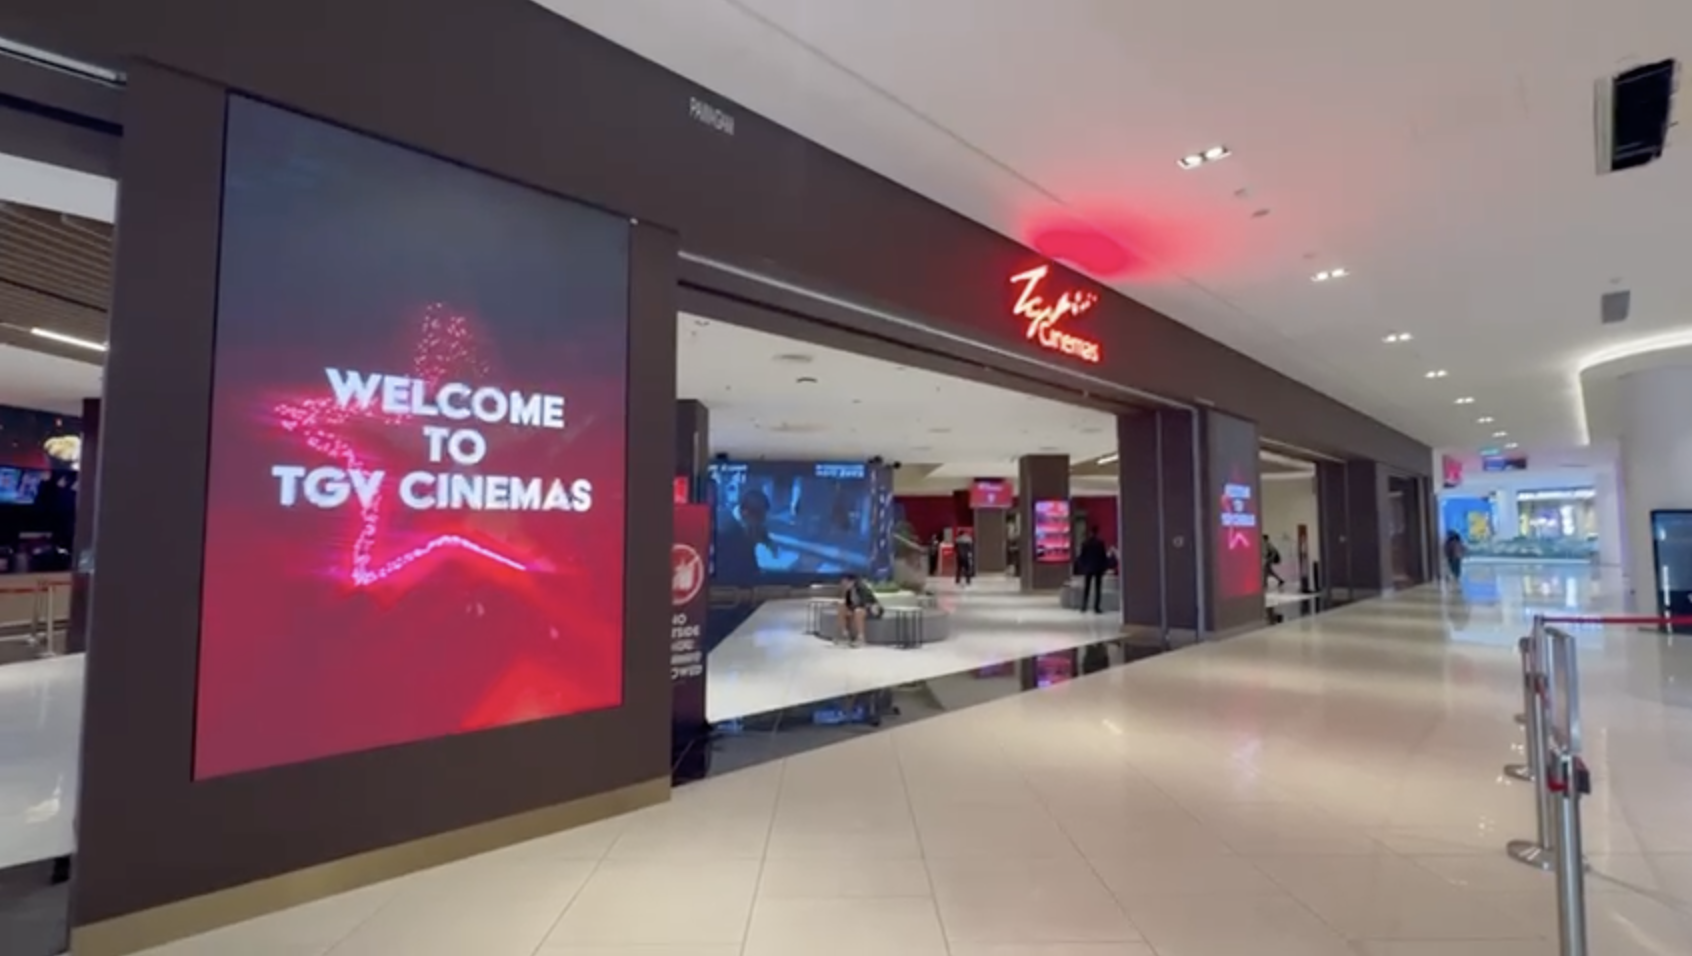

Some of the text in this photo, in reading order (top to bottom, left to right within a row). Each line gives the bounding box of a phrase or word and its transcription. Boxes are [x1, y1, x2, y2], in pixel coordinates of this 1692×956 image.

[1038, 320, 1099, 362] Cinemas
[325, 367, 565, 428] WELCOME
[423, 426, 487, 465] TO
[271, 465, 593, 512] TGV CINEMAS
